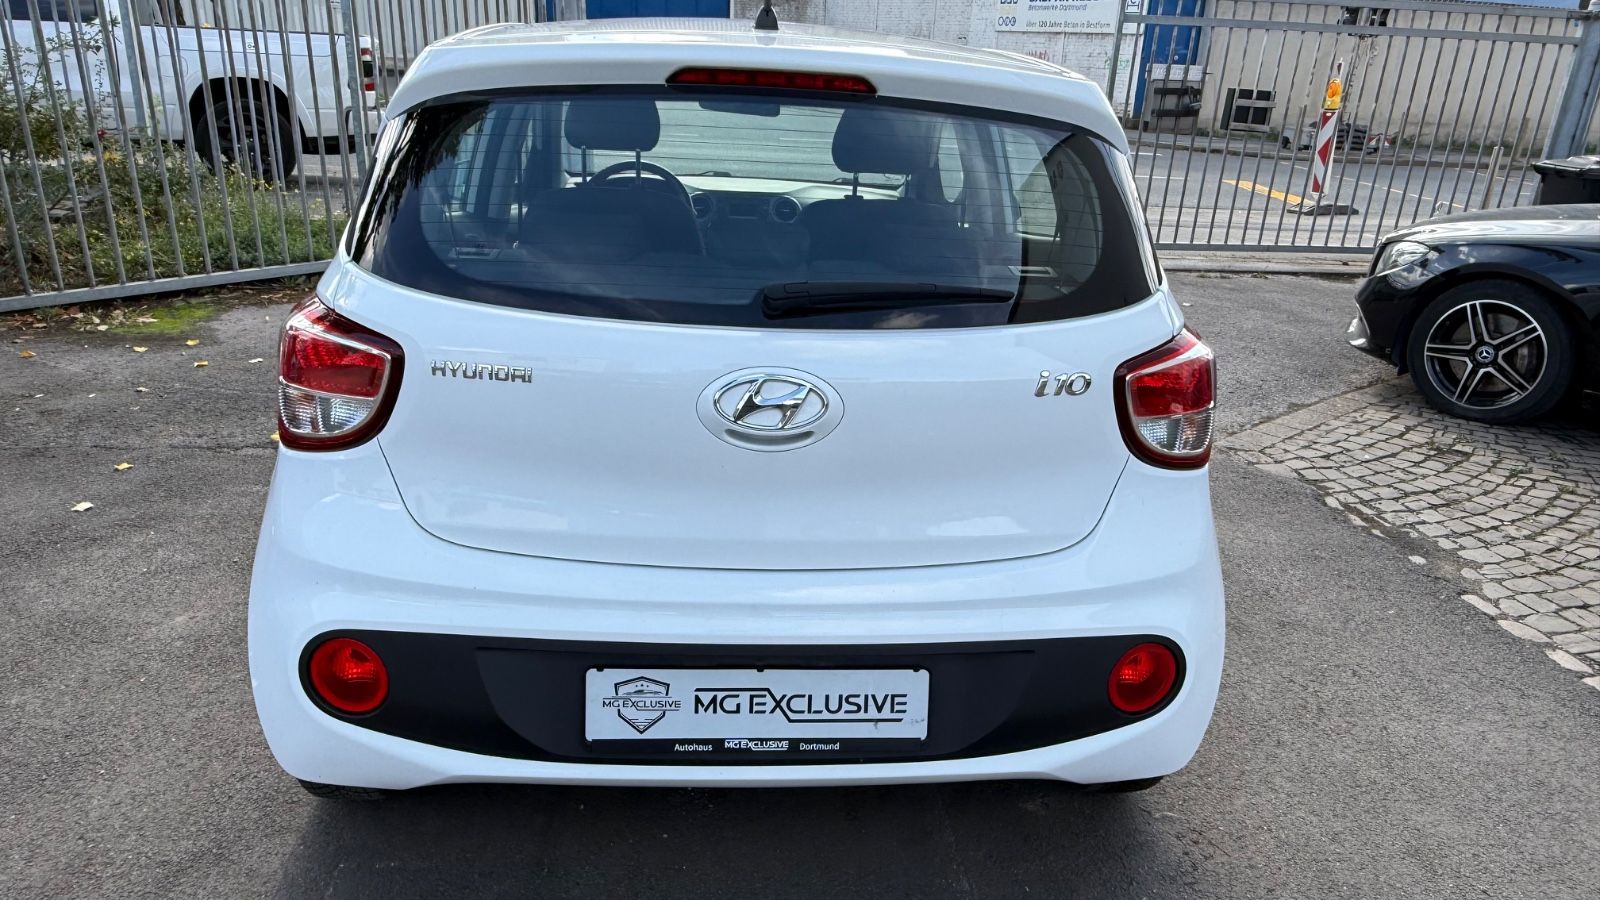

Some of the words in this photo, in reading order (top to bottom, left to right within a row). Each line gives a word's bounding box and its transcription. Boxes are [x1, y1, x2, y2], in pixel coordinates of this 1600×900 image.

[1038, 20, 1048, 28] 120
[1048, 20, 1063, 28] Jahre
[431, 360, 532, 383] HYUNDAI
[1034, 370, 1092, 397] i10
[602, 700, 620, 708] MG
[622, 700, 682, 709] EXCLUSIVE
[694, 693, 741, 714] MG
[748, 693, 908, 716] EXCLUSIVE
[674, 743, 713, 752] Autohaus
[724, 740, 740, 749] MG
[741, 740, 789, 750] EXCLUSIVE
[799, 742, 840, 750] Dortmund
